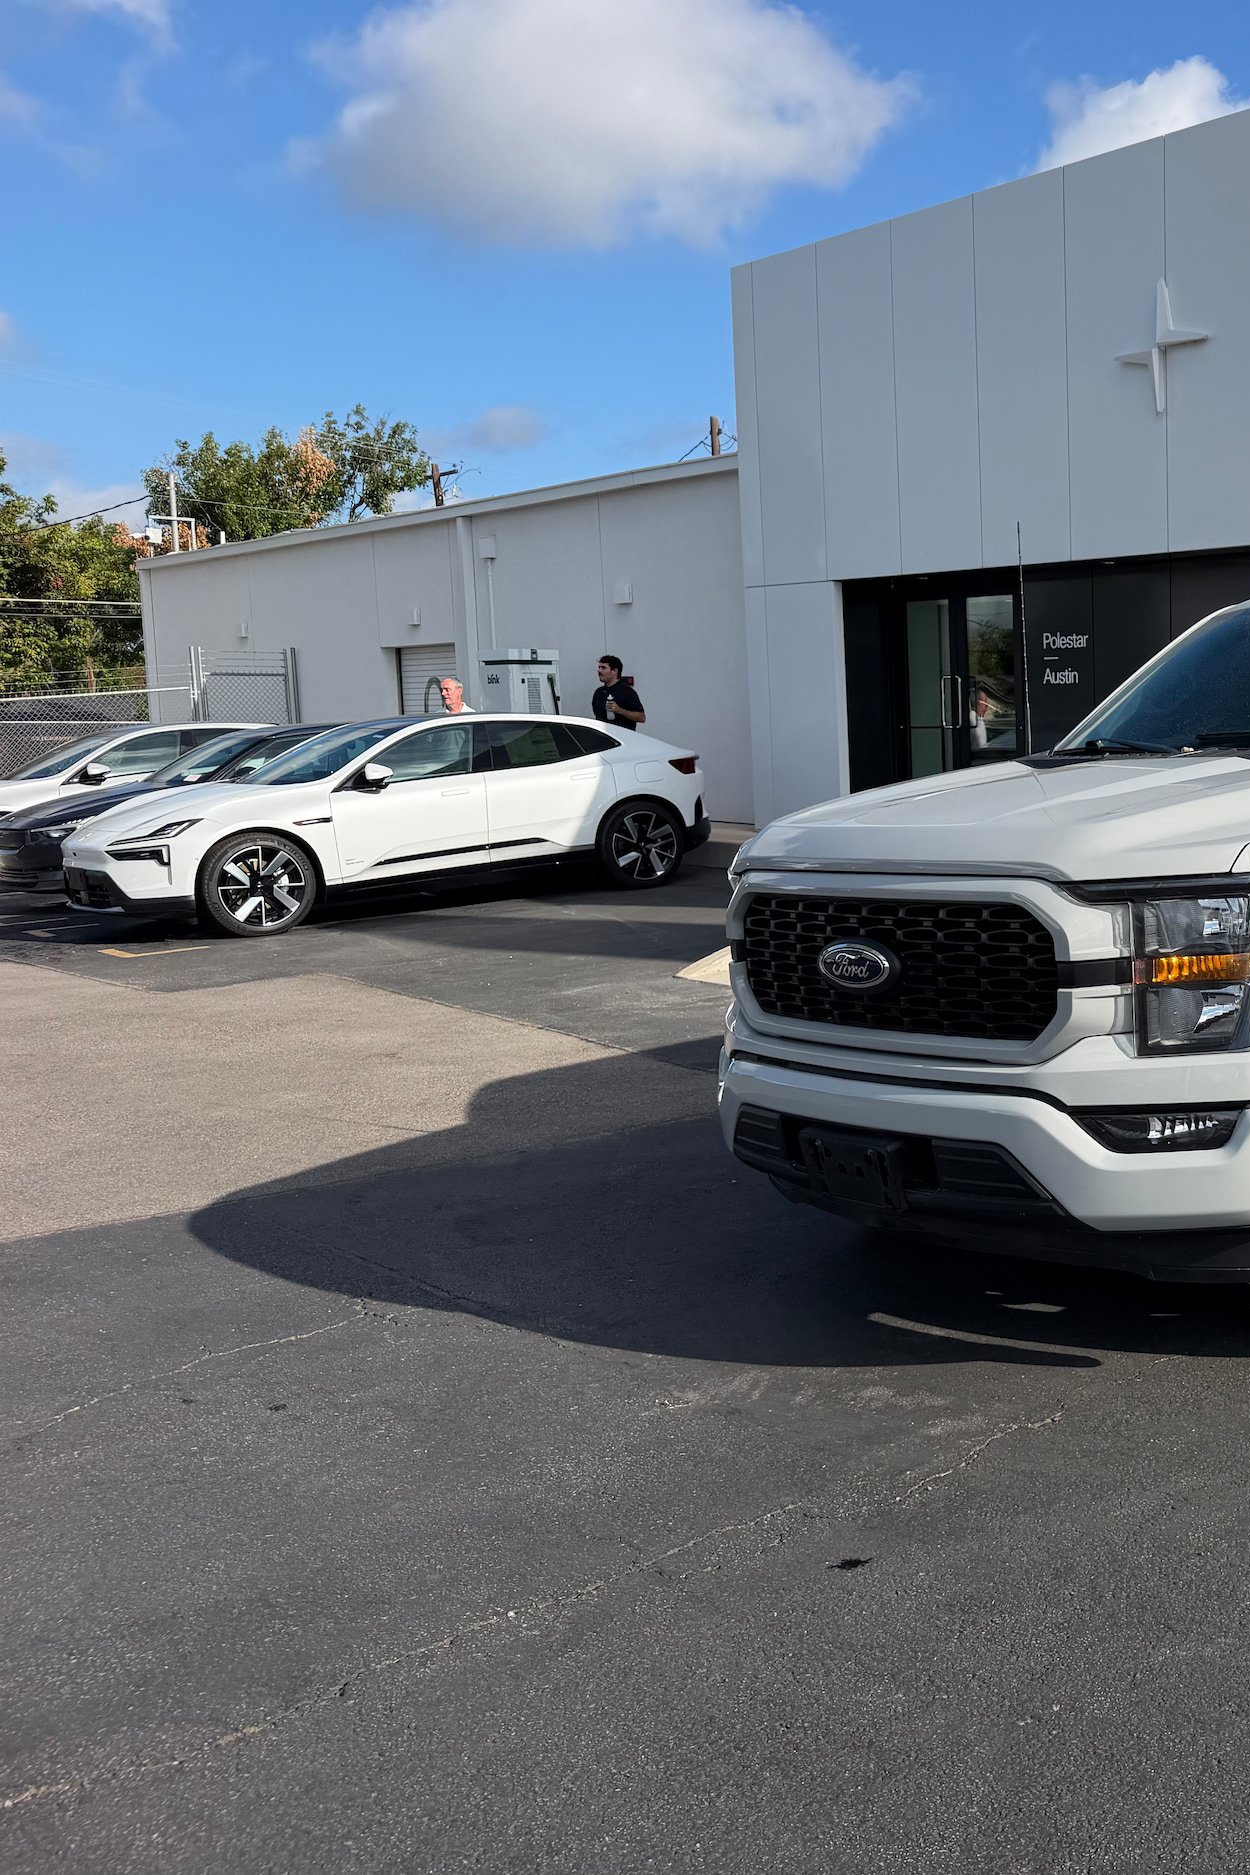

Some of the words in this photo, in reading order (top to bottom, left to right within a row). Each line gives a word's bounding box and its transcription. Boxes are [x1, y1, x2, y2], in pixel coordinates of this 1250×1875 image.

[1043, 632, 1089, 649] Polestar
[1043, 668, 1079, 685] Austin
[826, 953, 870, 978] Ford
